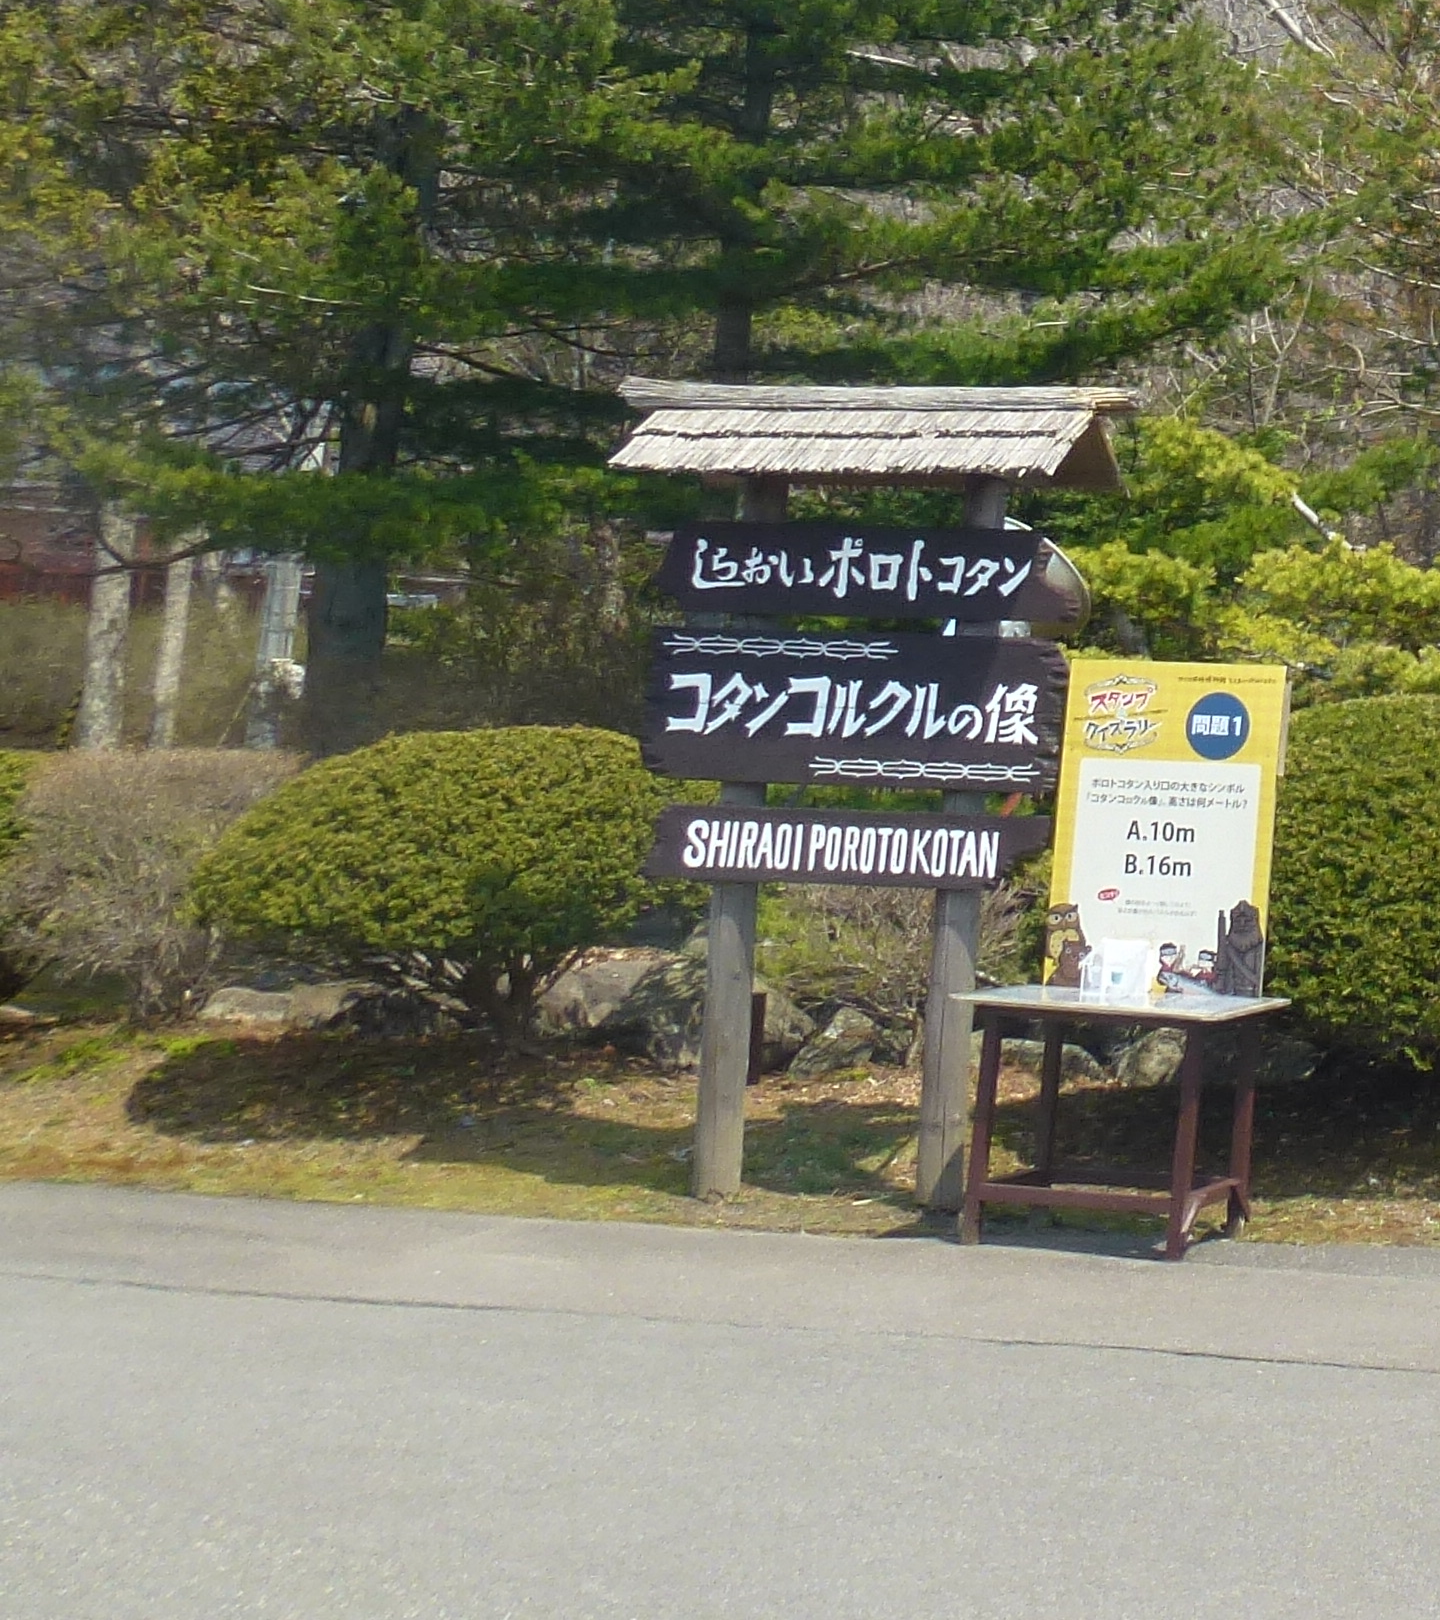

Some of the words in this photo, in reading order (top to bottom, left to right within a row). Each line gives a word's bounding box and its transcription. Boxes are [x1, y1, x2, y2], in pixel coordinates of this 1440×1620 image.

[692, 537, 1033, 601] しらおいポロトコタン
[665, 672, 1038, 745] コタンコルクルの像
[1091, 686, 1154, 713] スタンプ
[1085, 718, 1161, 742] クイズラリー
[1126, 820, 1196, 844] A.10m
[683, 819, 803, 871] SHIRAOI
[807, 823, 908, 875] POROTO
[908, 828, 1001, 879] KOTAN
[1124, 854, 1192, 878] B.16m
